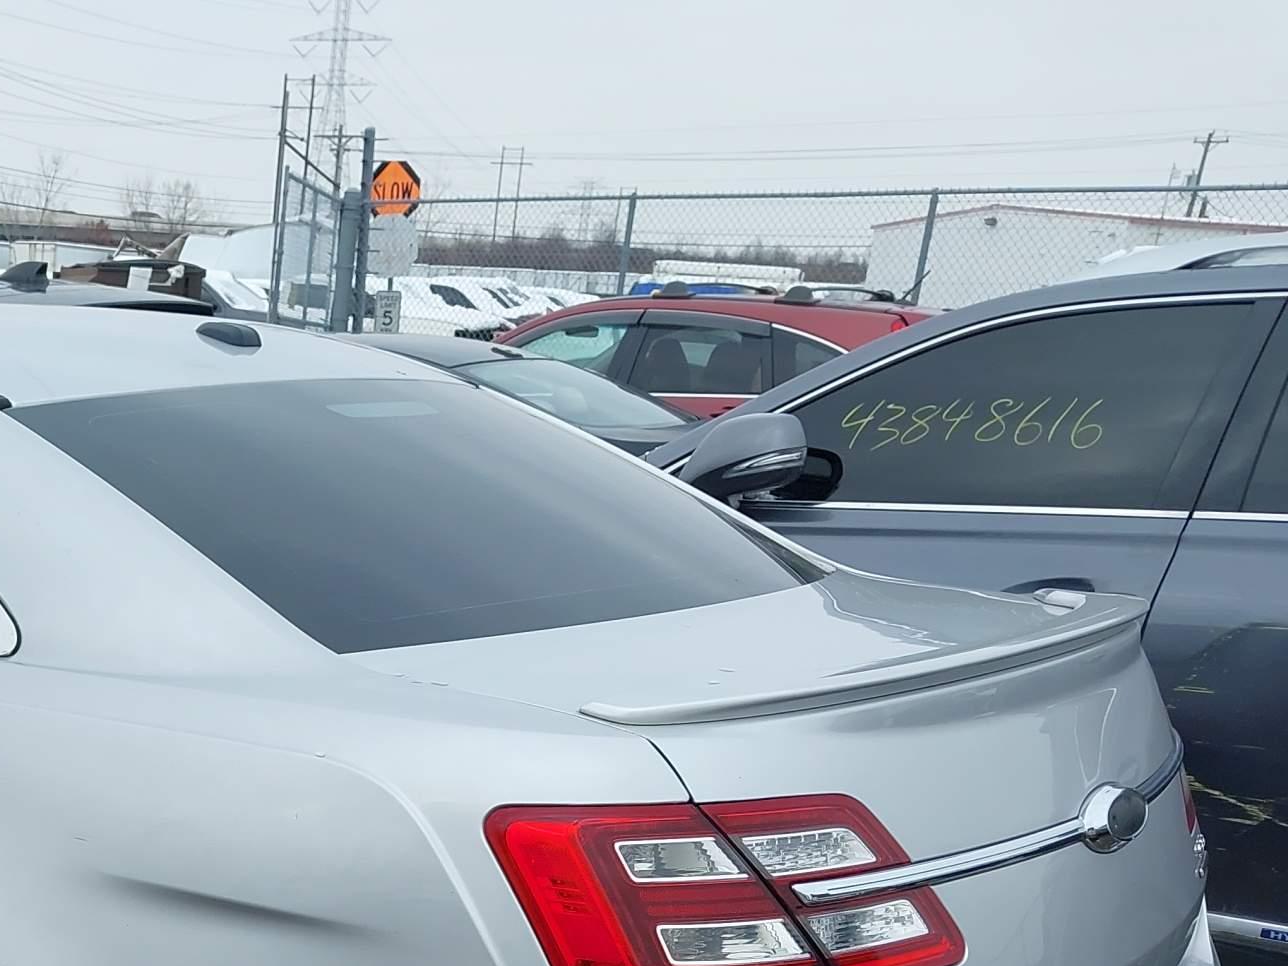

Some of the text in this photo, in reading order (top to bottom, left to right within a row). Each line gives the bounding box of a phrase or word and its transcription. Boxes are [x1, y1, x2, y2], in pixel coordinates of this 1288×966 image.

[373, 182, 413, 201] SLOW
[379, 294, 399, 302] SPEED
[382, 310, 393, 326] 5
[841, 397, 1104, 451] 43848616
